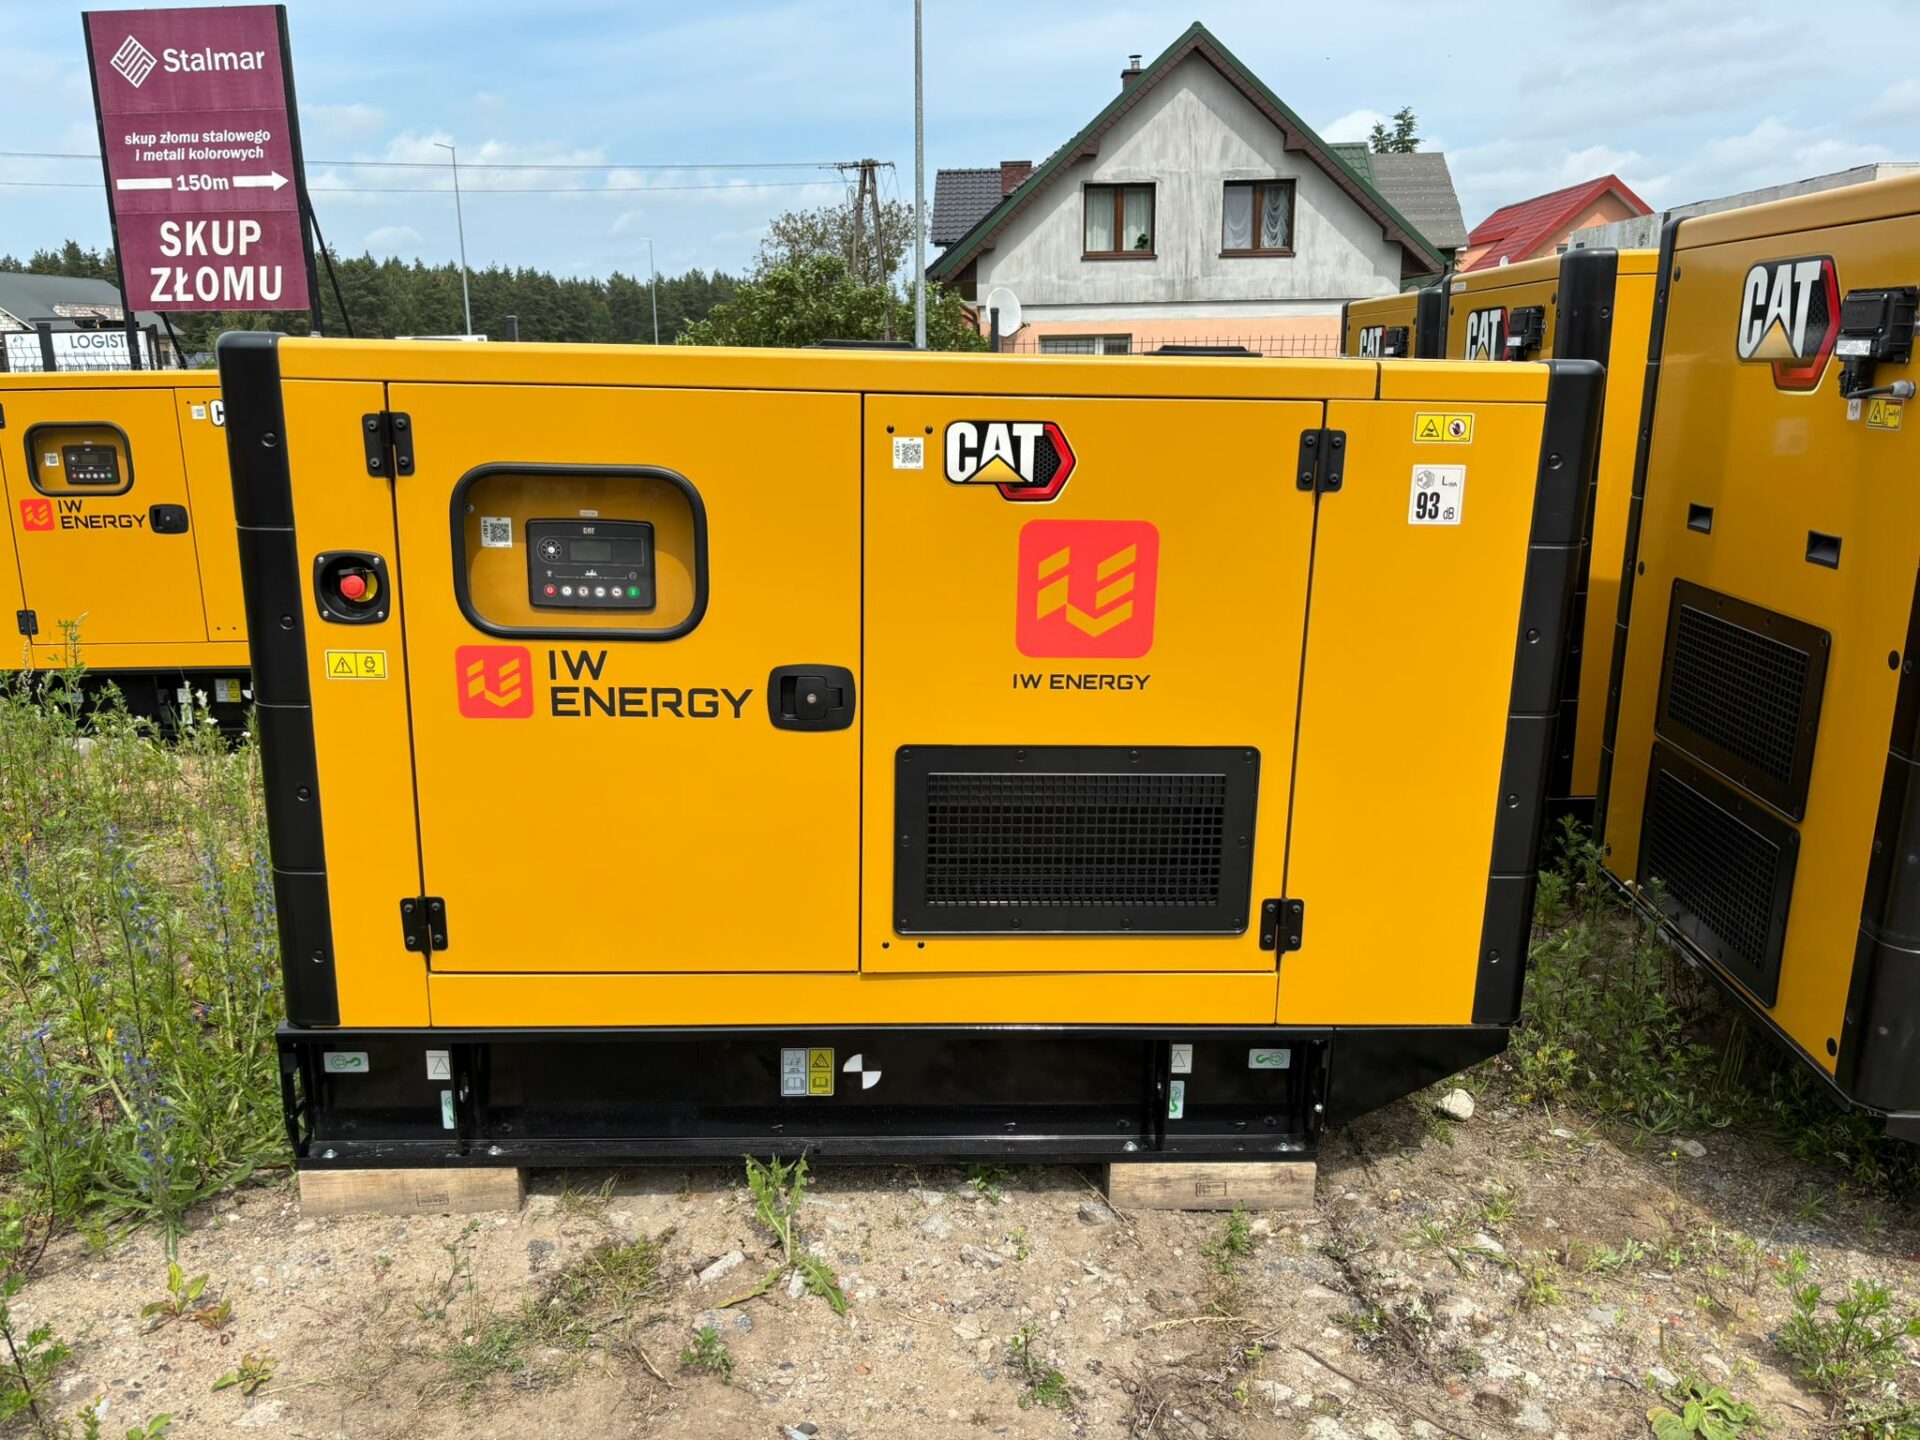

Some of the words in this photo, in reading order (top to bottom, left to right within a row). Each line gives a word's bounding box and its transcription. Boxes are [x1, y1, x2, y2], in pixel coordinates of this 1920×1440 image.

[162, 47, 265, 73] Stalmar
[124, 132, 157, 147] skup
[160, 131, 199, 144] złomu
[202, 129, 271, 143] stalowego
[135, 148, 140, 161] i
[143, 148, 185, 161] metali
[188, 146, 264, 161] kolorowych
[176, 174, 229, 191] 150m
[159, 220, 262, 257] SKUP
[150, 265, 282, 302] ZŁOMU
[1738, 260, 1822, 359] CAT
[1359, 326, 1383, 358] CAT
[1465, 308, 1502, 361] CAT
[946, 421, 1044, 483] CAT
[57, 499, 83, 514] IW
[1415, 491, 1441, 520] 93
[1442, 506, 1455, 520] dB
[60, 514, 146, 530] ENERGY
[548, 649, 608, 681] IW
[1012, 673, 1043, 689] IW
[1049, 673, 1151, 690] ENERGY
[550, 686, 754, 719] ENERGY
